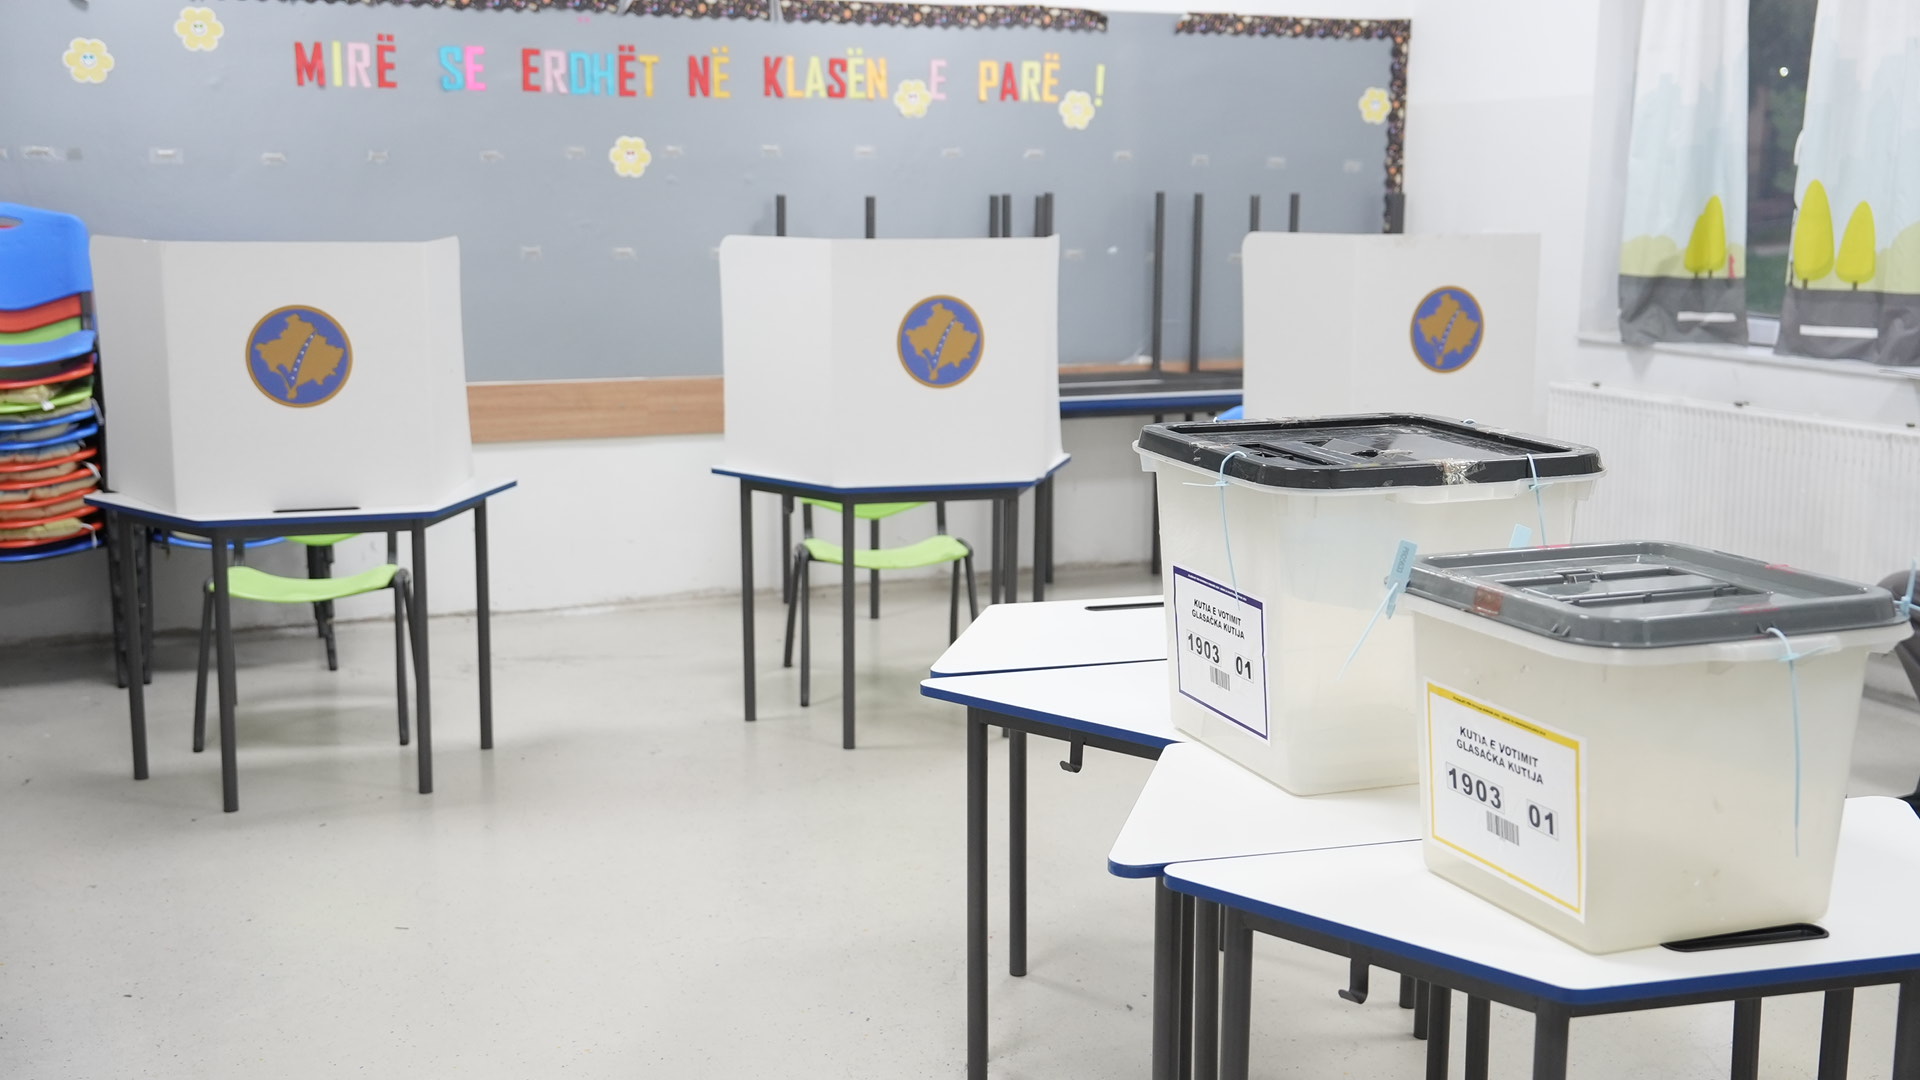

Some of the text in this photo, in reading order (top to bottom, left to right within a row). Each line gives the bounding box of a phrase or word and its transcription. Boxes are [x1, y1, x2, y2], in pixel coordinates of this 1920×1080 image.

[294, 33, 397, 88] MIRË
[438, 45, 487, 92] SE
[522, 45, 660, 97] ERDHËT
[687, 47, 731, 99] NË
[763, 48, 888, 100] KLASËN
[930, 58, 947, 102] E
[977, 53, 1060, 103] PARË
[1194, 599, 1241, 626] KUTIA E VOTIMIT
[1223, 623, 1245, 640] KUTIJA
[1188, 633, 1252, 680] 1903 01
[1459, 726, 1539, 767] KUTIA E VOTIMIT
[1507, 761, 1544, 785] KUTIJA
[1448, 767, 1554, 836] 1903 01
